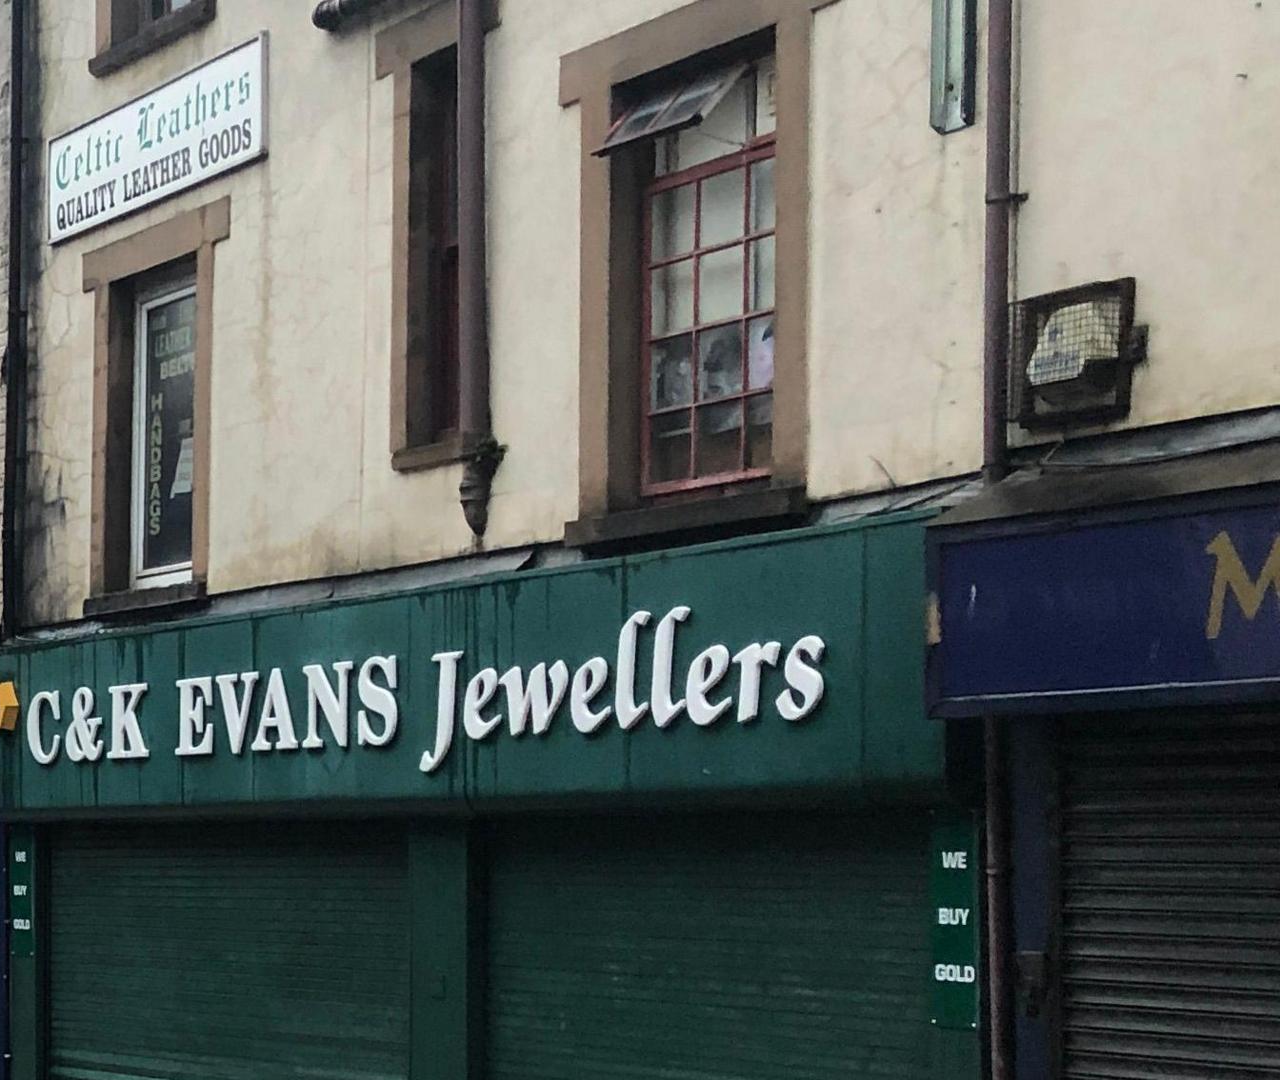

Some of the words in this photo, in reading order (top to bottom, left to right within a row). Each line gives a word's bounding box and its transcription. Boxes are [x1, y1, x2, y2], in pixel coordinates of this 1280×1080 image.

[55, 129, 124, 190] Celtic
[137, 71, 250, 151] Leathers
[56, 178, 117, 230] QUALITY
[122, 146, 192, 203] LEATHER
[198, 118, 252, 169] GOODS
[26, 681, 151, 766] C&K
[174, 655, 399, 758] EVANS
[418, 606, 826, 773] Jewellers
[942, 851, 967, 869] WE
[13, 885, 27, 896] BUY
[13, 918, 30, 930] GOLD
[938, 907, 970, 926] BUY
[934, 963, 975, 983] GOLD
